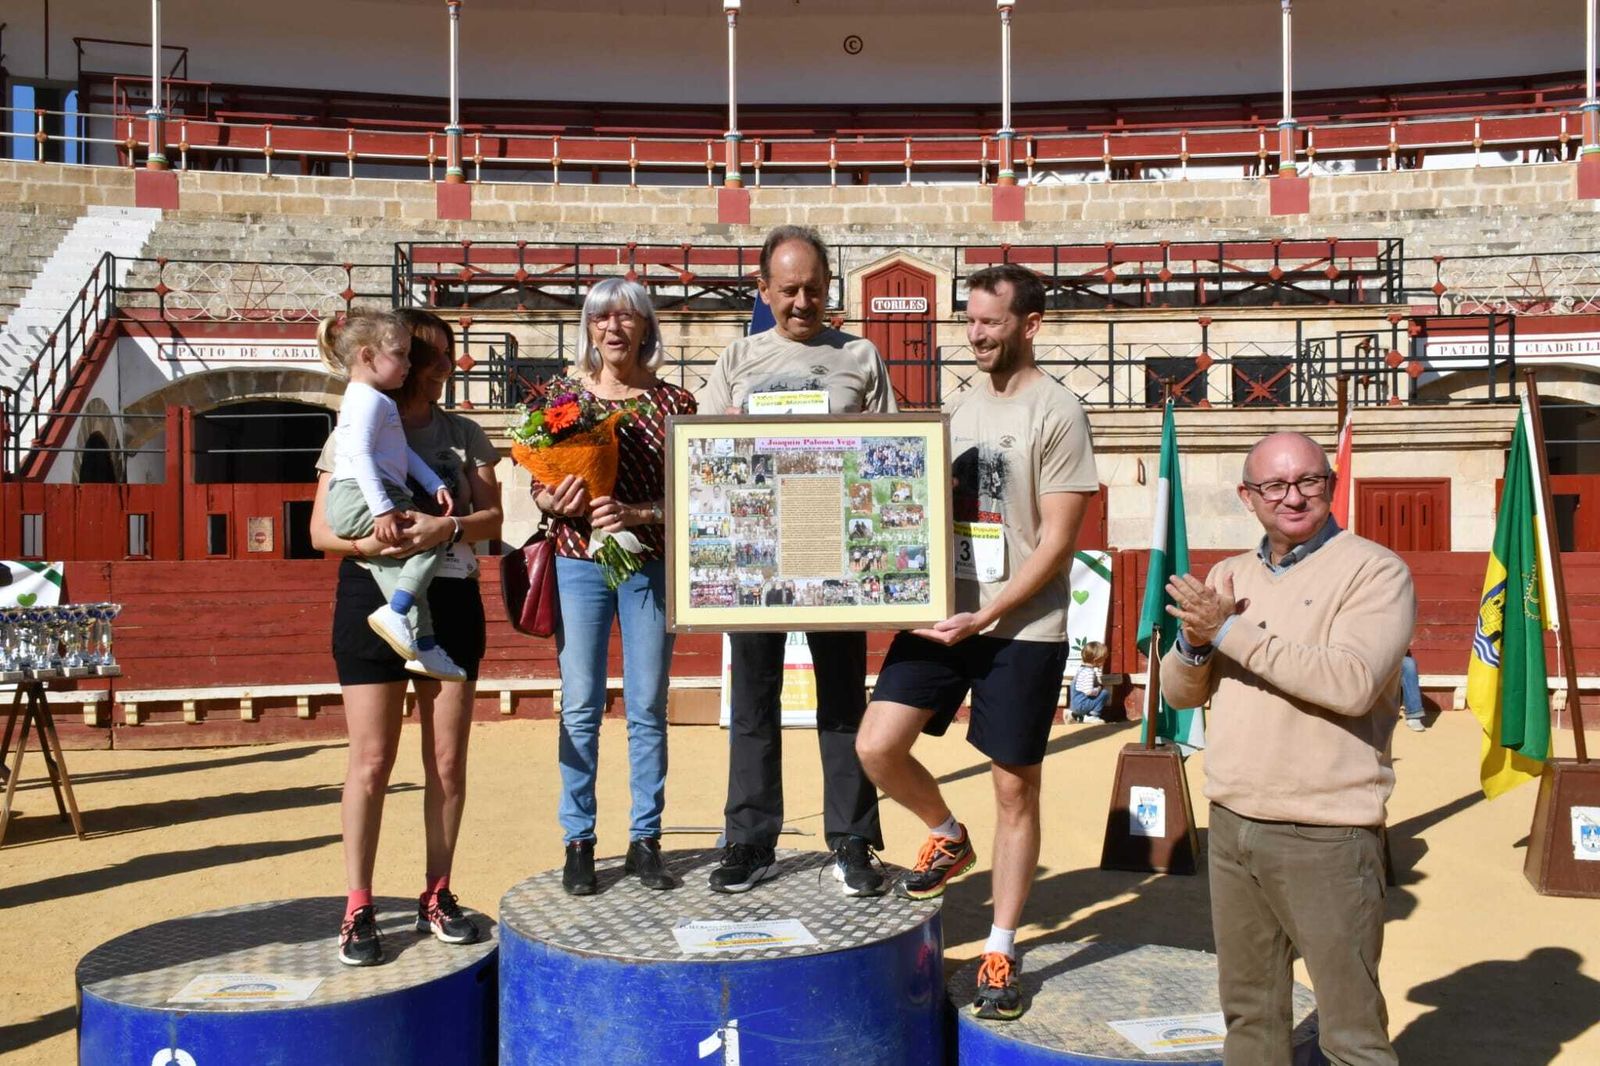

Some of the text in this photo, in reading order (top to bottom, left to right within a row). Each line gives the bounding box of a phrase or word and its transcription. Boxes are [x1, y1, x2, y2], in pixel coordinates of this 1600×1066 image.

[875, 300, 924, 310] TORILES
[178, 347, 226, 357] PATIO
[240, 347, 258, 358] DE
[1440, 345, 1488, 356] PATIO
[1497, 344, 1509, 354] D
[960, 540, 971, 561] 3
